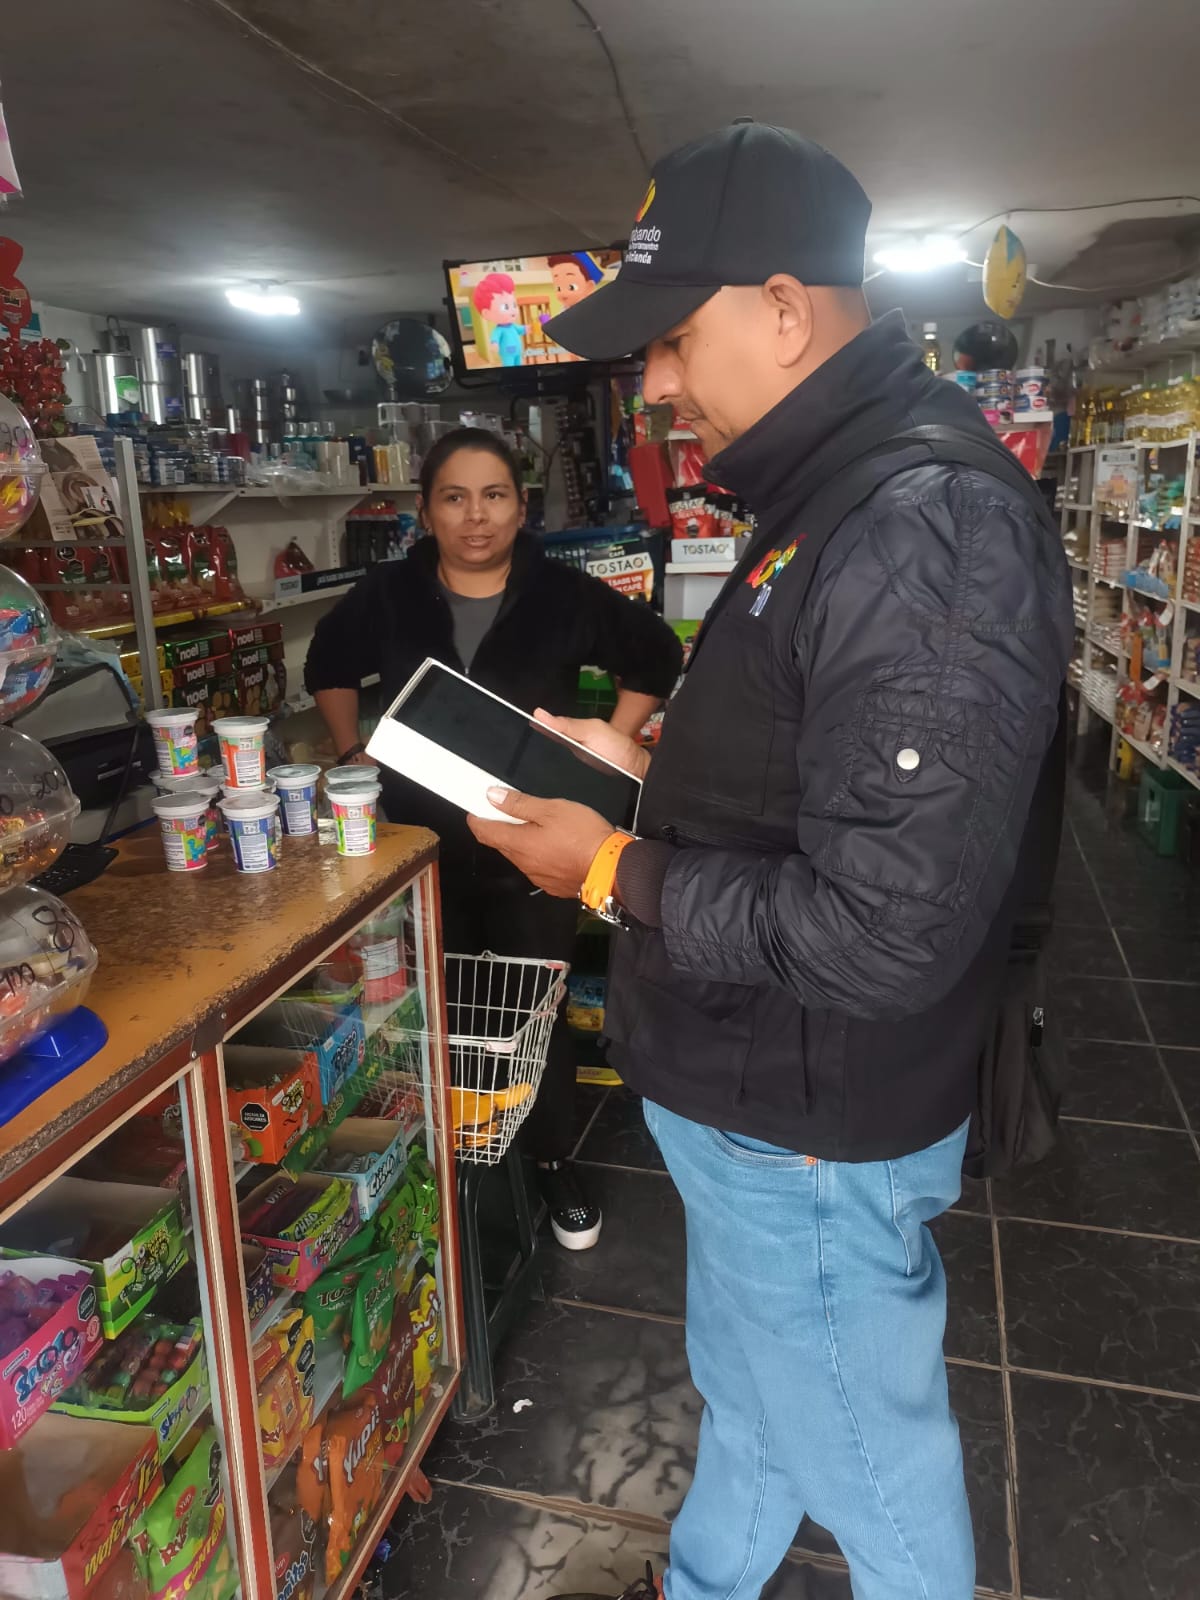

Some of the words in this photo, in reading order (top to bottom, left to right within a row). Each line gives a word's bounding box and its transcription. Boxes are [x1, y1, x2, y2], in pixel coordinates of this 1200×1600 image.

[236, 628, 255, 646] noel
[180, 643, 200, 661] noel
[241, 650, 260, 666] noel
[186, 664, 206, 682] noel
[244, 668, 264, 687] noel
[186, 683, 209, 706] noel
[11, 1406, 27, 1431] 120
